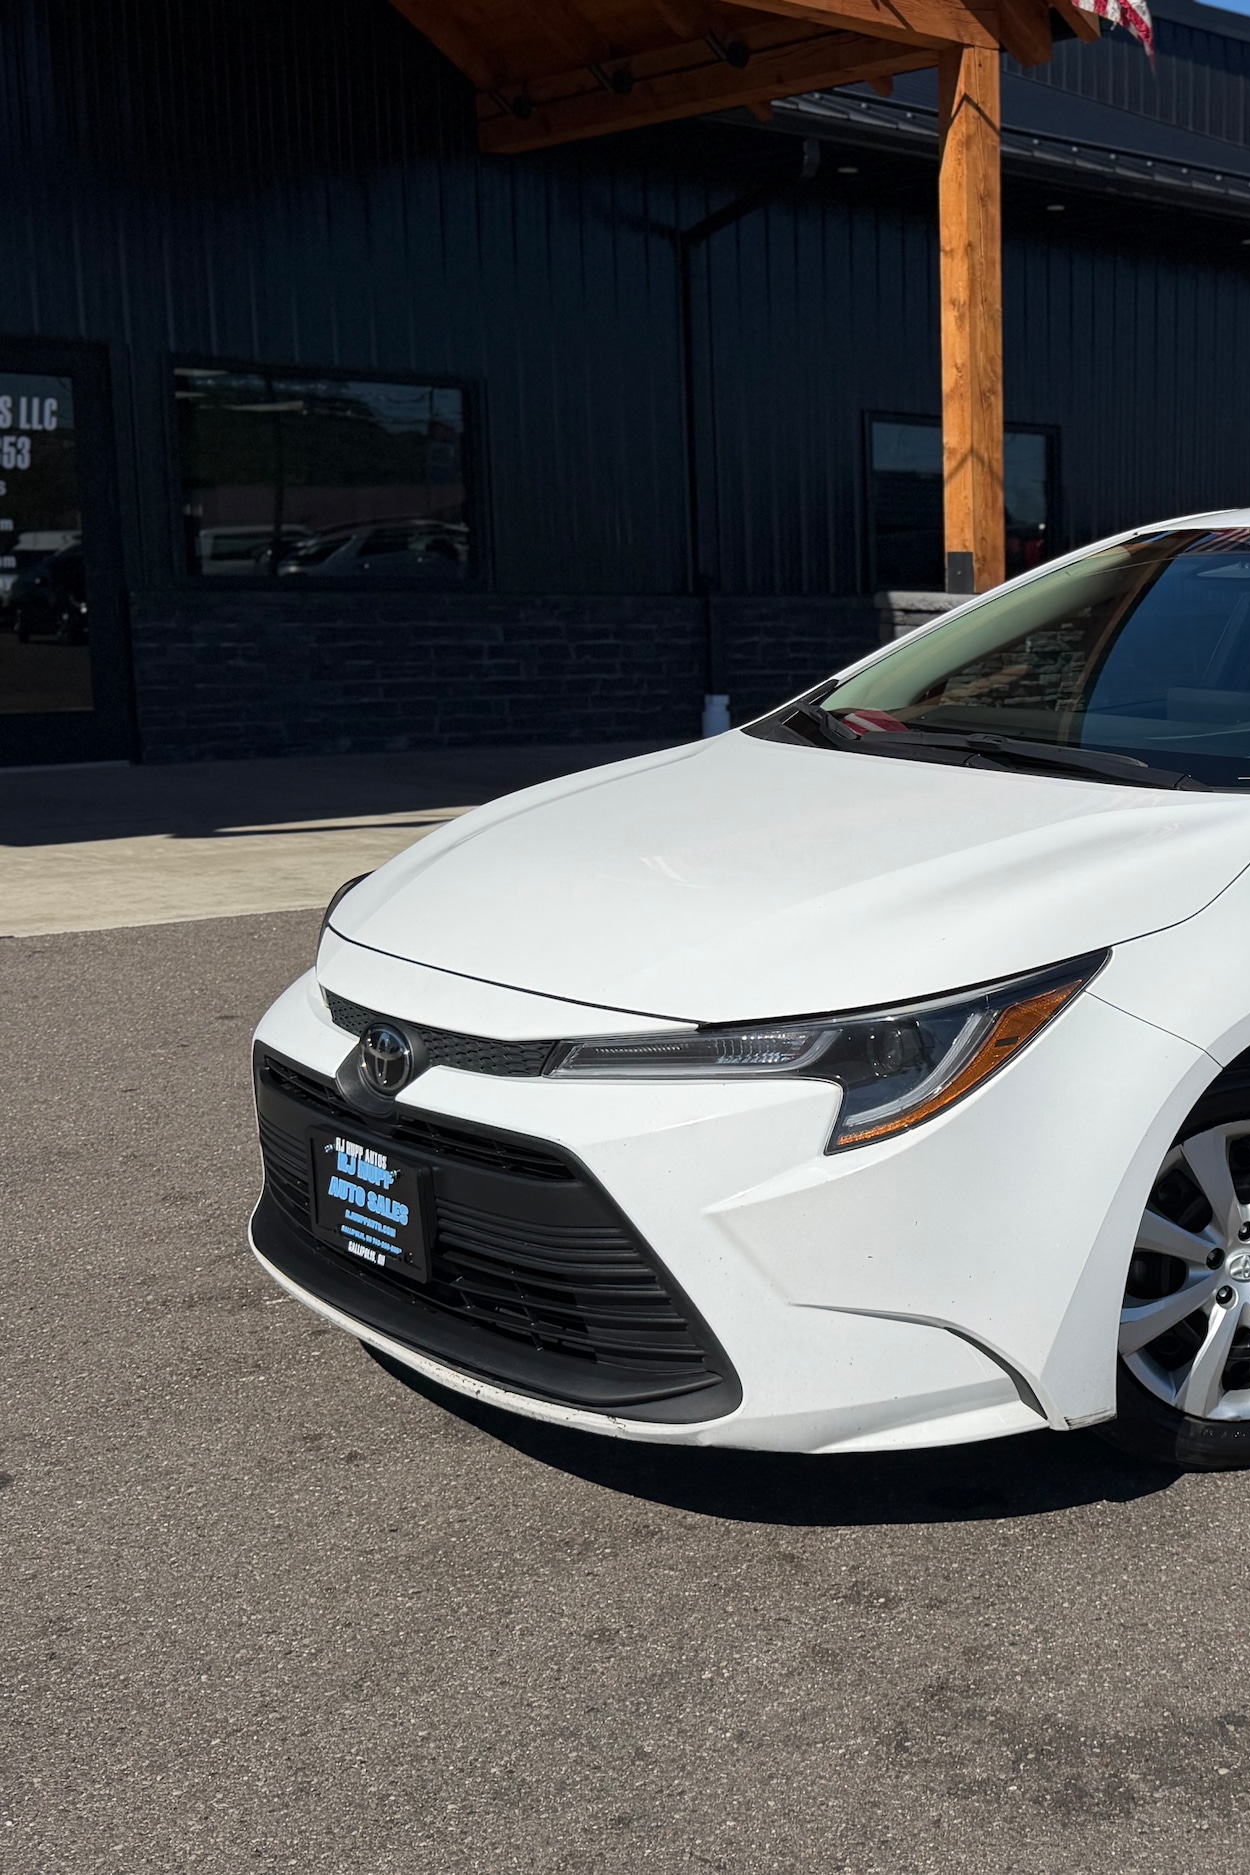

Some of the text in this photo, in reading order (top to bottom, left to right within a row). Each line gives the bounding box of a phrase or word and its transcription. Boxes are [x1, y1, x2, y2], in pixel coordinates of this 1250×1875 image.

[19, 396, 58, 431] LLC
[0, 435, 31, 470] 53
[328, 1175, 409, 1226] AUTO SALES
